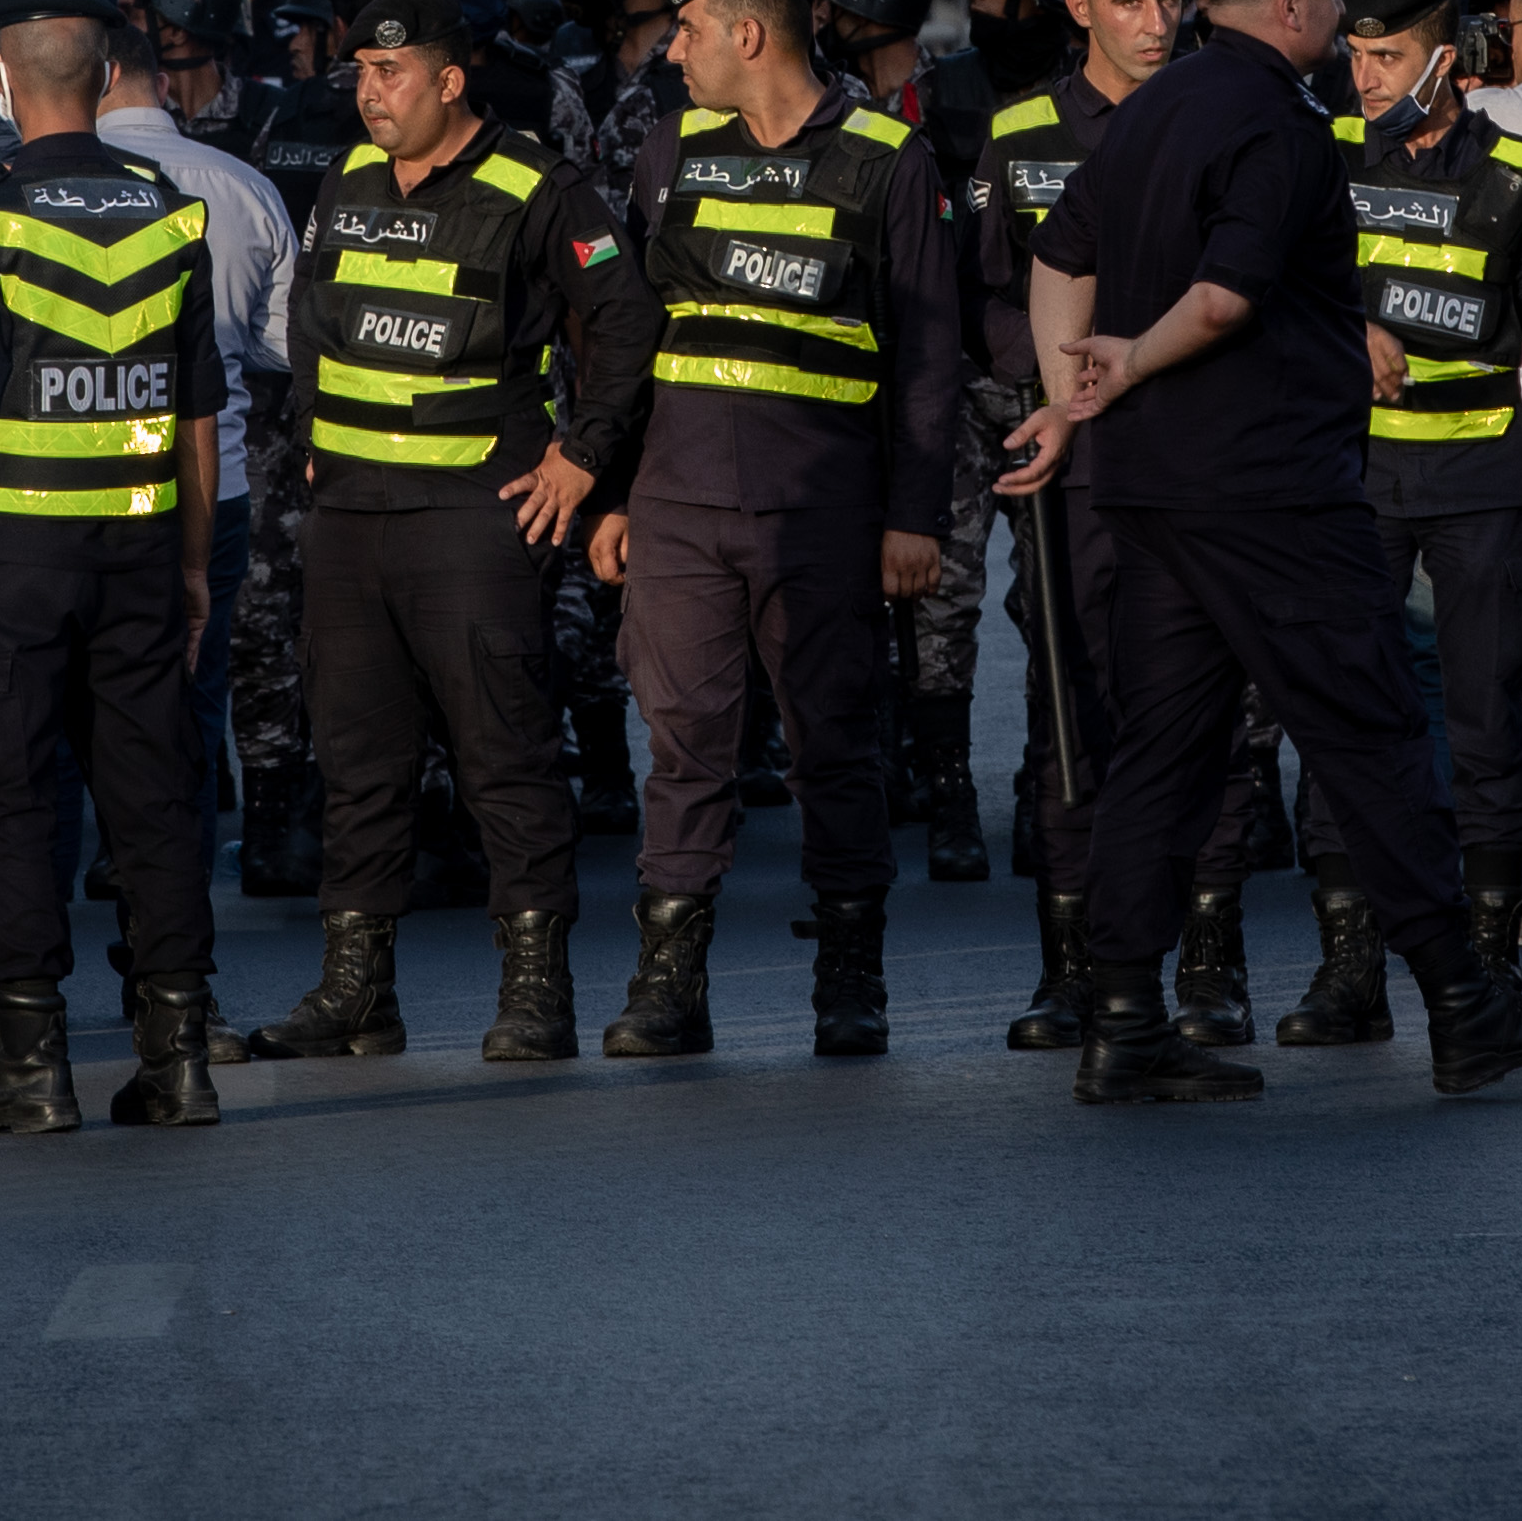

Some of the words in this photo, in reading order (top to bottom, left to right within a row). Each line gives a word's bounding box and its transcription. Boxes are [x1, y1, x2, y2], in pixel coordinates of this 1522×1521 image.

[685, 162, 800, 191] الشرطة
[34, 188, 158, 214] الشرطة
[1348, 188, 1450, 227] الشرط
[334, 212, 428, 243] الشرطة
[727, 249, 819, 293] POLICE
[1386, 286, 1481, 333] POLICE
[358, 313, 446, 353] POLICE
[41, 363, 169, 413] POLICE
